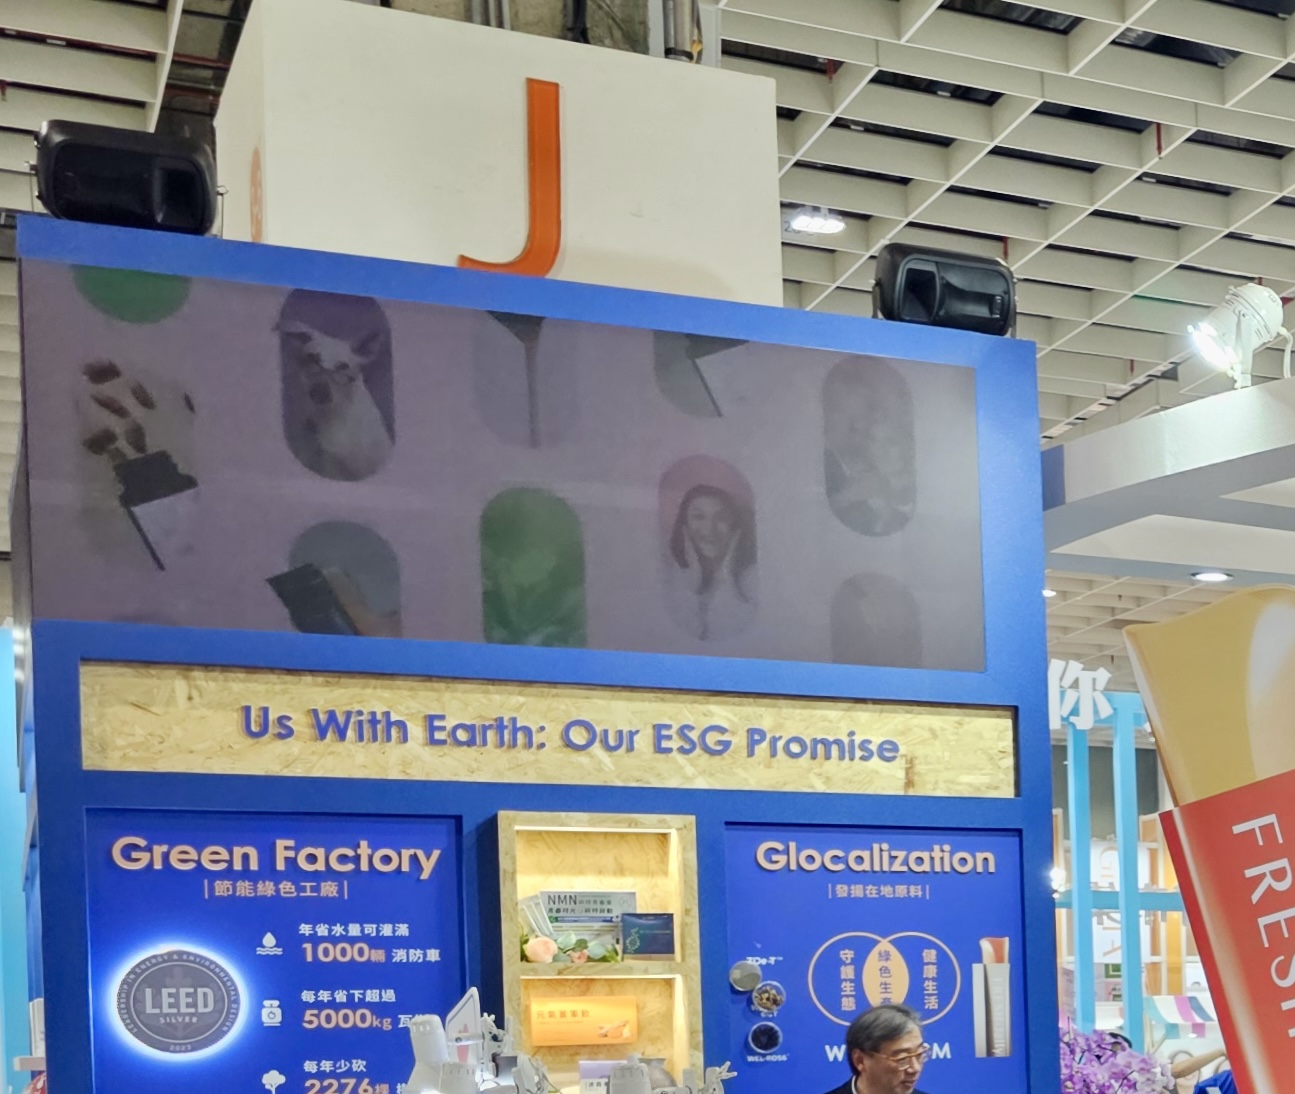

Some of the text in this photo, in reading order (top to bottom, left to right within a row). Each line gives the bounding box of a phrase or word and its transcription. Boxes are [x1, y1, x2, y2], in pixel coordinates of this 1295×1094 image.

[458, 77, 561, 277] J
[241, 704, 900, 764] Us With Earth: Our ESG Promise
[111, 835, 442, 880] Green Factory
[756, 840, 997, 876] Glocalization
[547, 894, 578, 906] NMN
[391, 948, 442, 963] 消防車
[839, 948, 856, 1011] 守護生態
[922, 948, 939, 1010] 健康生活
[145, 987, 215, 1014] LEED
[301, 989, 397, 1003] 每年省下超過
[159, 1016, 199, 1024] SILVER
[302, 1008, 393, 1030] 5000kg
[303, 1059, 367, 1073] 每年少砍
